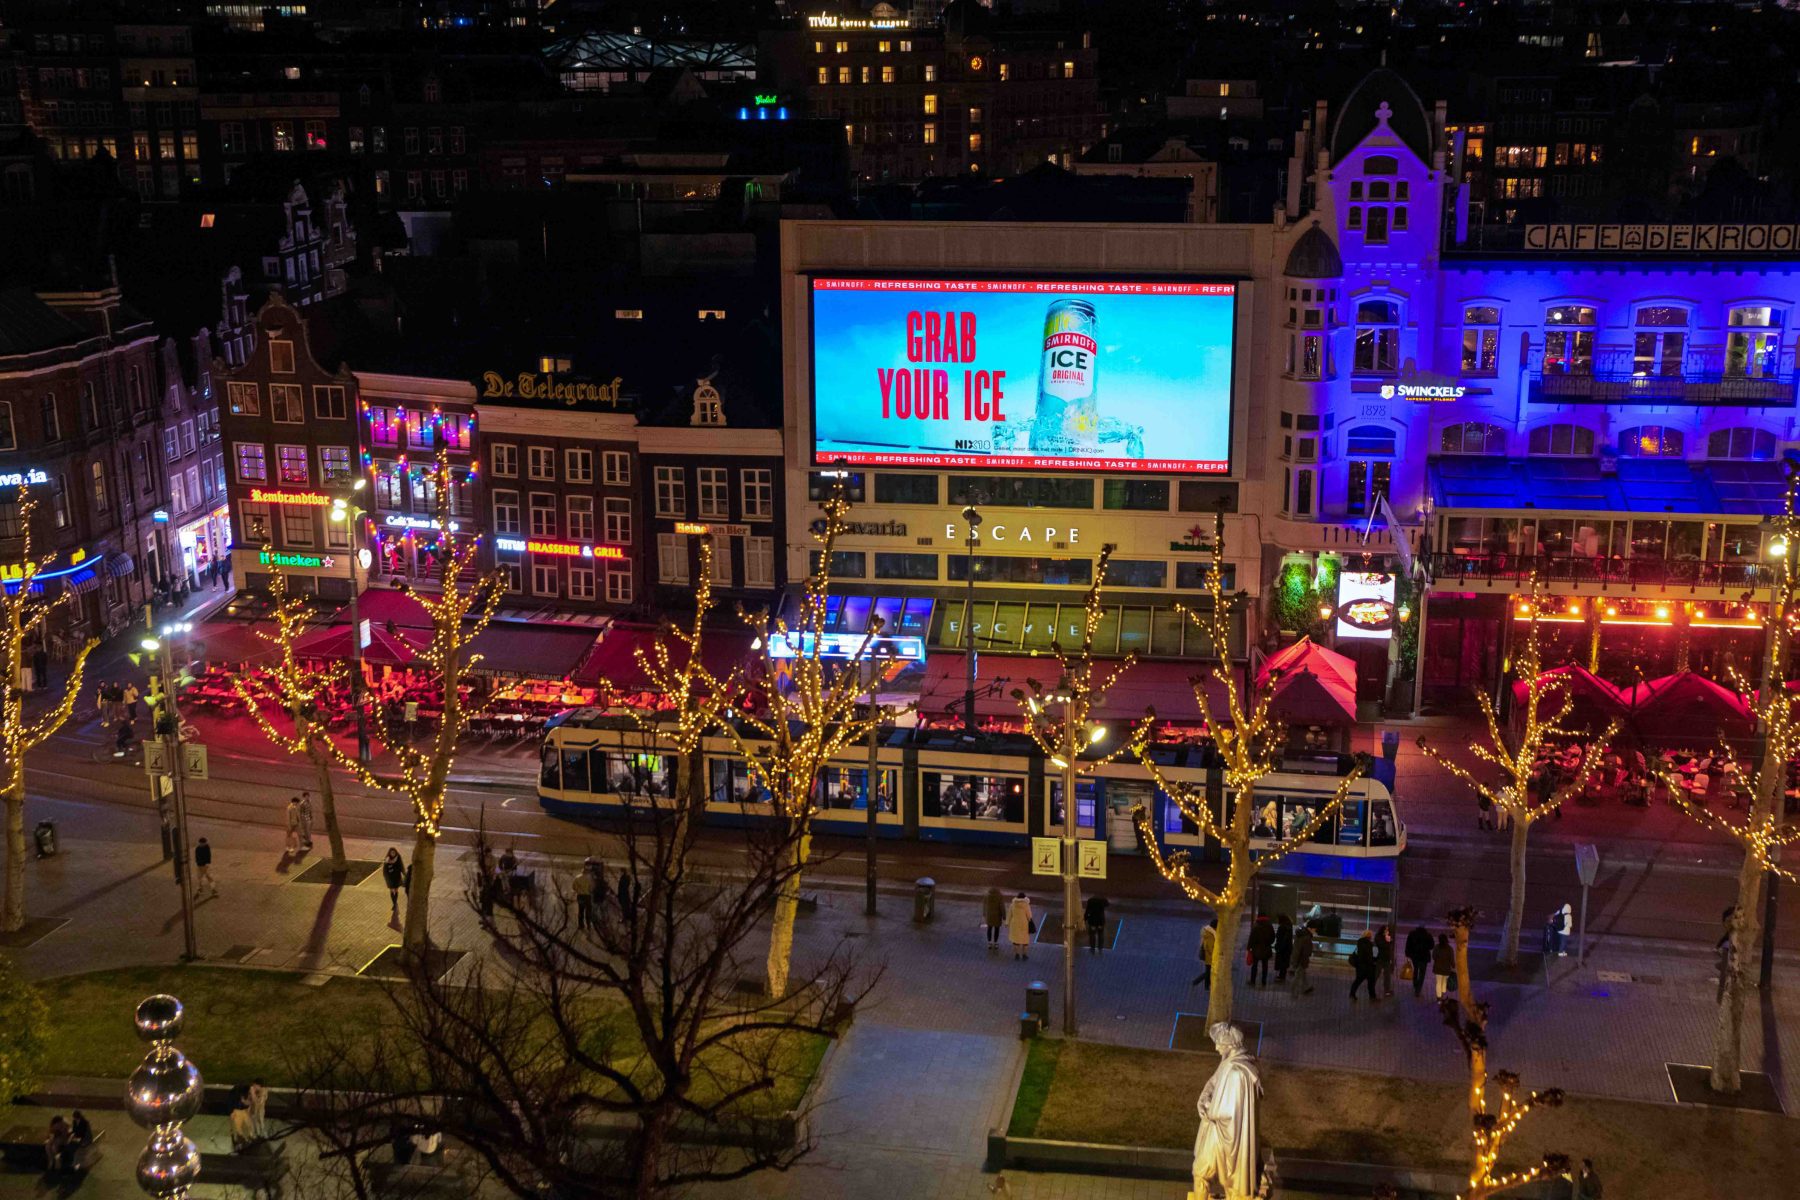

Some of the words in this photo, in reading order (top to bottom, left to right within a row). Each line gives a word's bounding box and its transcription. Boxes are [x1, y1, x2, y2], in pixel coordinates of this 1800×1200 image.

[808, 10, 838, 27] TIVOLI
[907, 310, 976, 363] GRAB
[1046, 334, 1095, 350] SMIRNOFF
[1051, 350, 1087, 369] ICE
[1052, 370, 1084, 381] ORIGINAL
[483, 371, 514, 398] De
[518, 372, 623, 408] Telegraaf
[877, 368, 949, 420] YOUR
[964, 369, 1006, 421] ICE
[1361, 405, 1386, 416] 1898
[955, 439, 991, 449] NIX18
[251, 489, 330, 505] Rembrandtbar
[727, 525, 747, 535] Bier
[946, 524, 1079, 543] ESCAPE
[496, 538, 526, 551] TITUS
[527, 541, 580, 555] BRASSERIE
[582, 545, 592, 557] &
[594, 546, 623, 558] GRILL
[260, 551, 321, 567] Heineken
